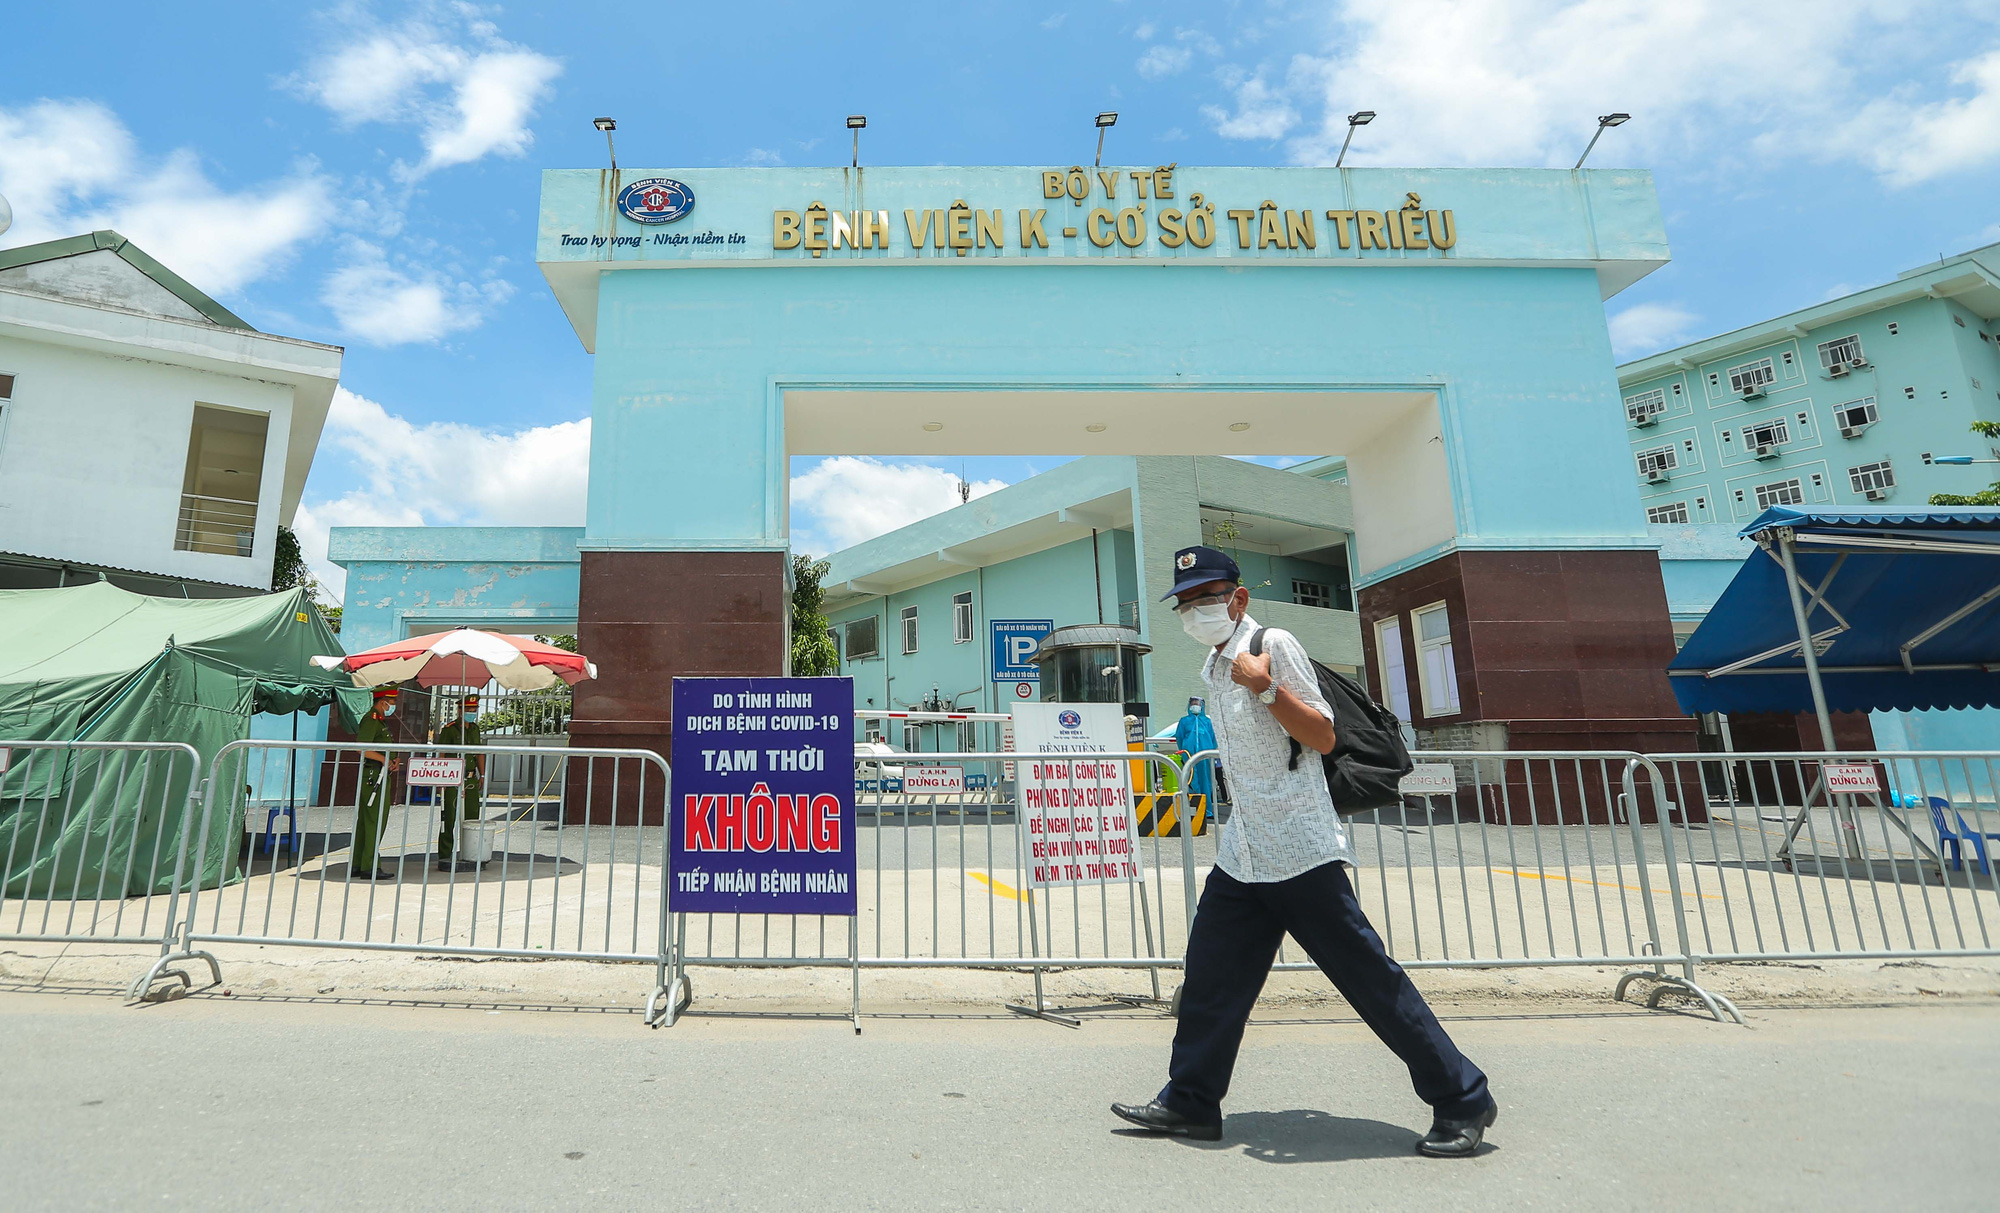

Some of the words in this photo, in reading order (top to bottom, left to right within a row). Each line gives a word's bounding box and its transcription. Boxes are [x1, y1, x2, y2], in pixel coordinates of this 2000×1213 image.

[1043, 166, 1089, 206] BỘ
[1097, 172, 1120, 199] Y
[1130, 162, 1177, 199] TẾ
[625, 210, 645, 222] NATIONAL
[665, 209, 685, 221] HOSPITAL
[773, 201, 889, 258] BỆNH
[904, 201, 1001, 257] VIỆN
[1019, 209, 1049, 248] K
[1087, 202, 1147, 249] CƠ
[1158, 193, 1215, 249] SỞ
[1228, 200, 1316, 250] TÂN
[1326, 192, 1457, 250] TRIỀU
[561, 234, 587, 246] Trao
[591, 235, 607, 248] hy
[611, 236, 642, 248] vọng
[653, 233, 689, 247] Nhận
[692, 230, 724, 245] niềm
[728, 233, 746, 244] tin
[1011, 637, 1037, 664] P
[713, 693, 733, 708] DO
[737, 691, 771, 708] TÌNH
[776, 690, 812, 708] HÌNH
[687, 716, 722, 734] DỊCH
[726, 713, 766, 734] BỆNH
[771, 715, 839, 731] COVID-19
[702, 750, 757, 776] TẠM
[766, 744, 824, 771] THỜI
[1033, 764, 1054, 780] ĐM
[1100, 760, 1117, 779] TÁC
[411, 767, 440, 778] DỪNG
[442, 770, 459, 780] LẠI
[908, 775, 939, 786] DỪNG
[941, 778, 960, 788] LẠI
[1830, 774, 1858, 785] DỪNG
[1859, 776, 1875, 787] LẠI
[684, 781, 842, 853] KHÔNG
[1047, 817, 1070, 836] NGHỊ
[1074, 812, 1093, 832] CÁC
[1097, 816, 1109, 832] E
[678, 866, 709, 893] TIẾP
[714, 869, 756, 897] NHẬN
[760, 869, 801, 897] BỆNH
[805, 869, 848, 893] NHÂN
